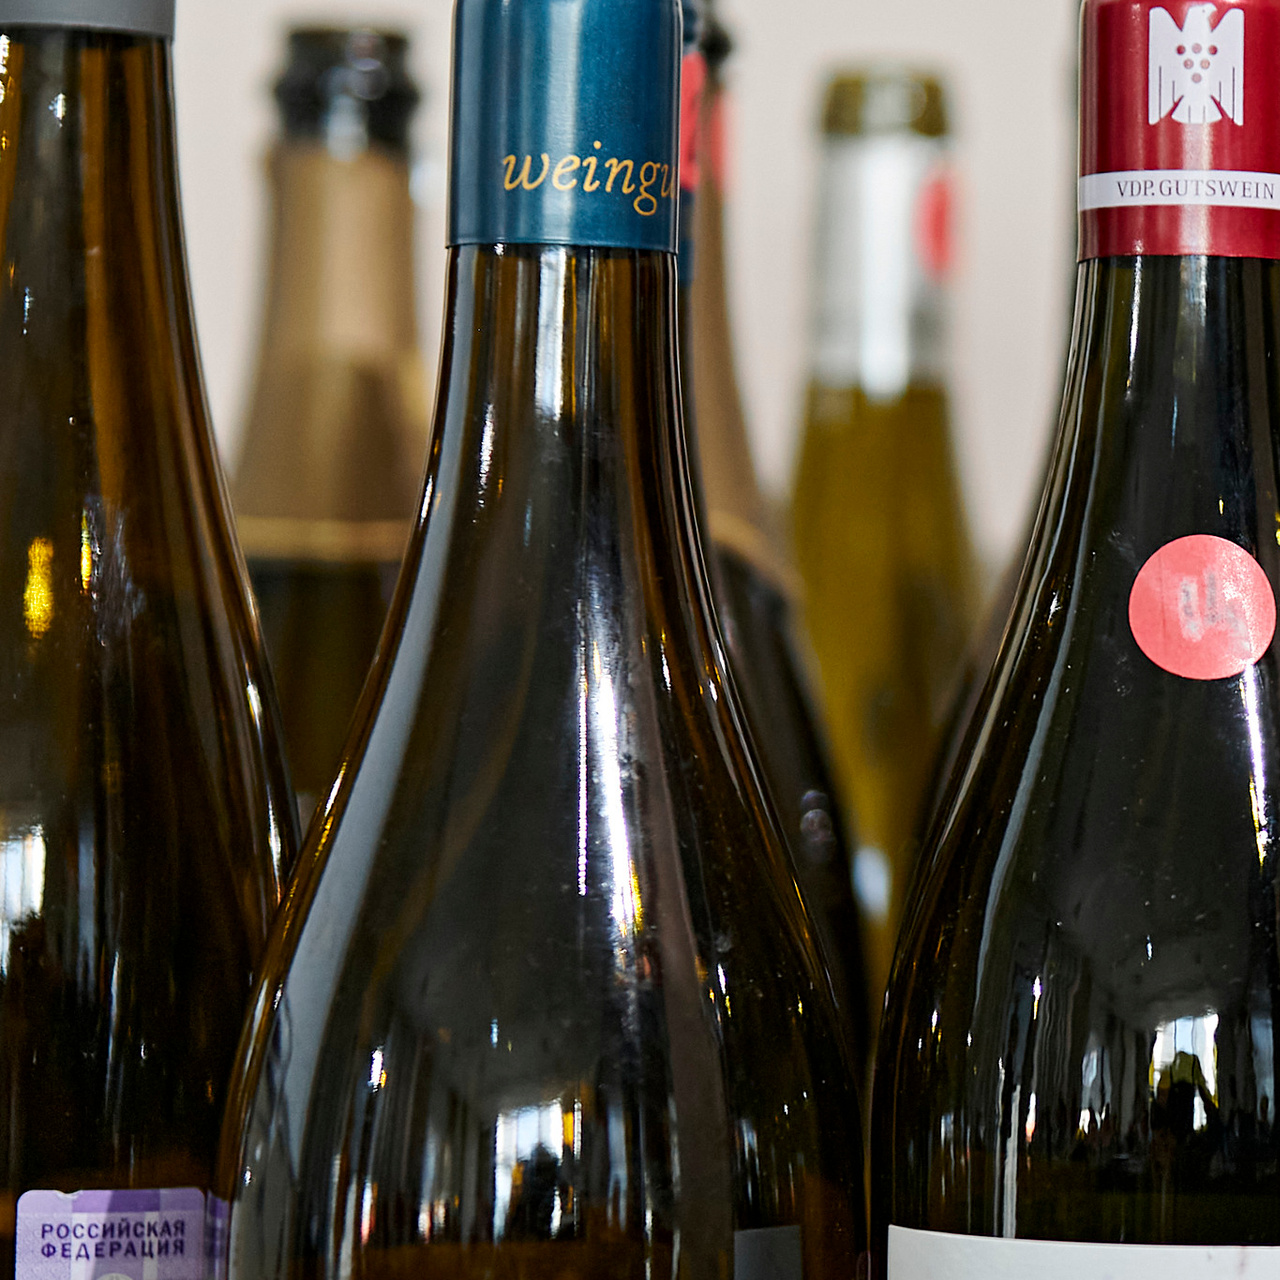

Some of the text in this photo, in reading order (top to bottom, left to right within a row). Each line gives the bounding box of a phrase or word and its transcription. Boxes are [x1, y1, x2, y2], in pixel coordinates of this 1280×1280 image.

[1117, 179, 1276, 200] VDP.GUTSWEIN
[40, 1219, 186, 1240] РОССИЙСКАЯ
[40, 1239, 186, 1261] ФЕДЕРАЦИЯ
